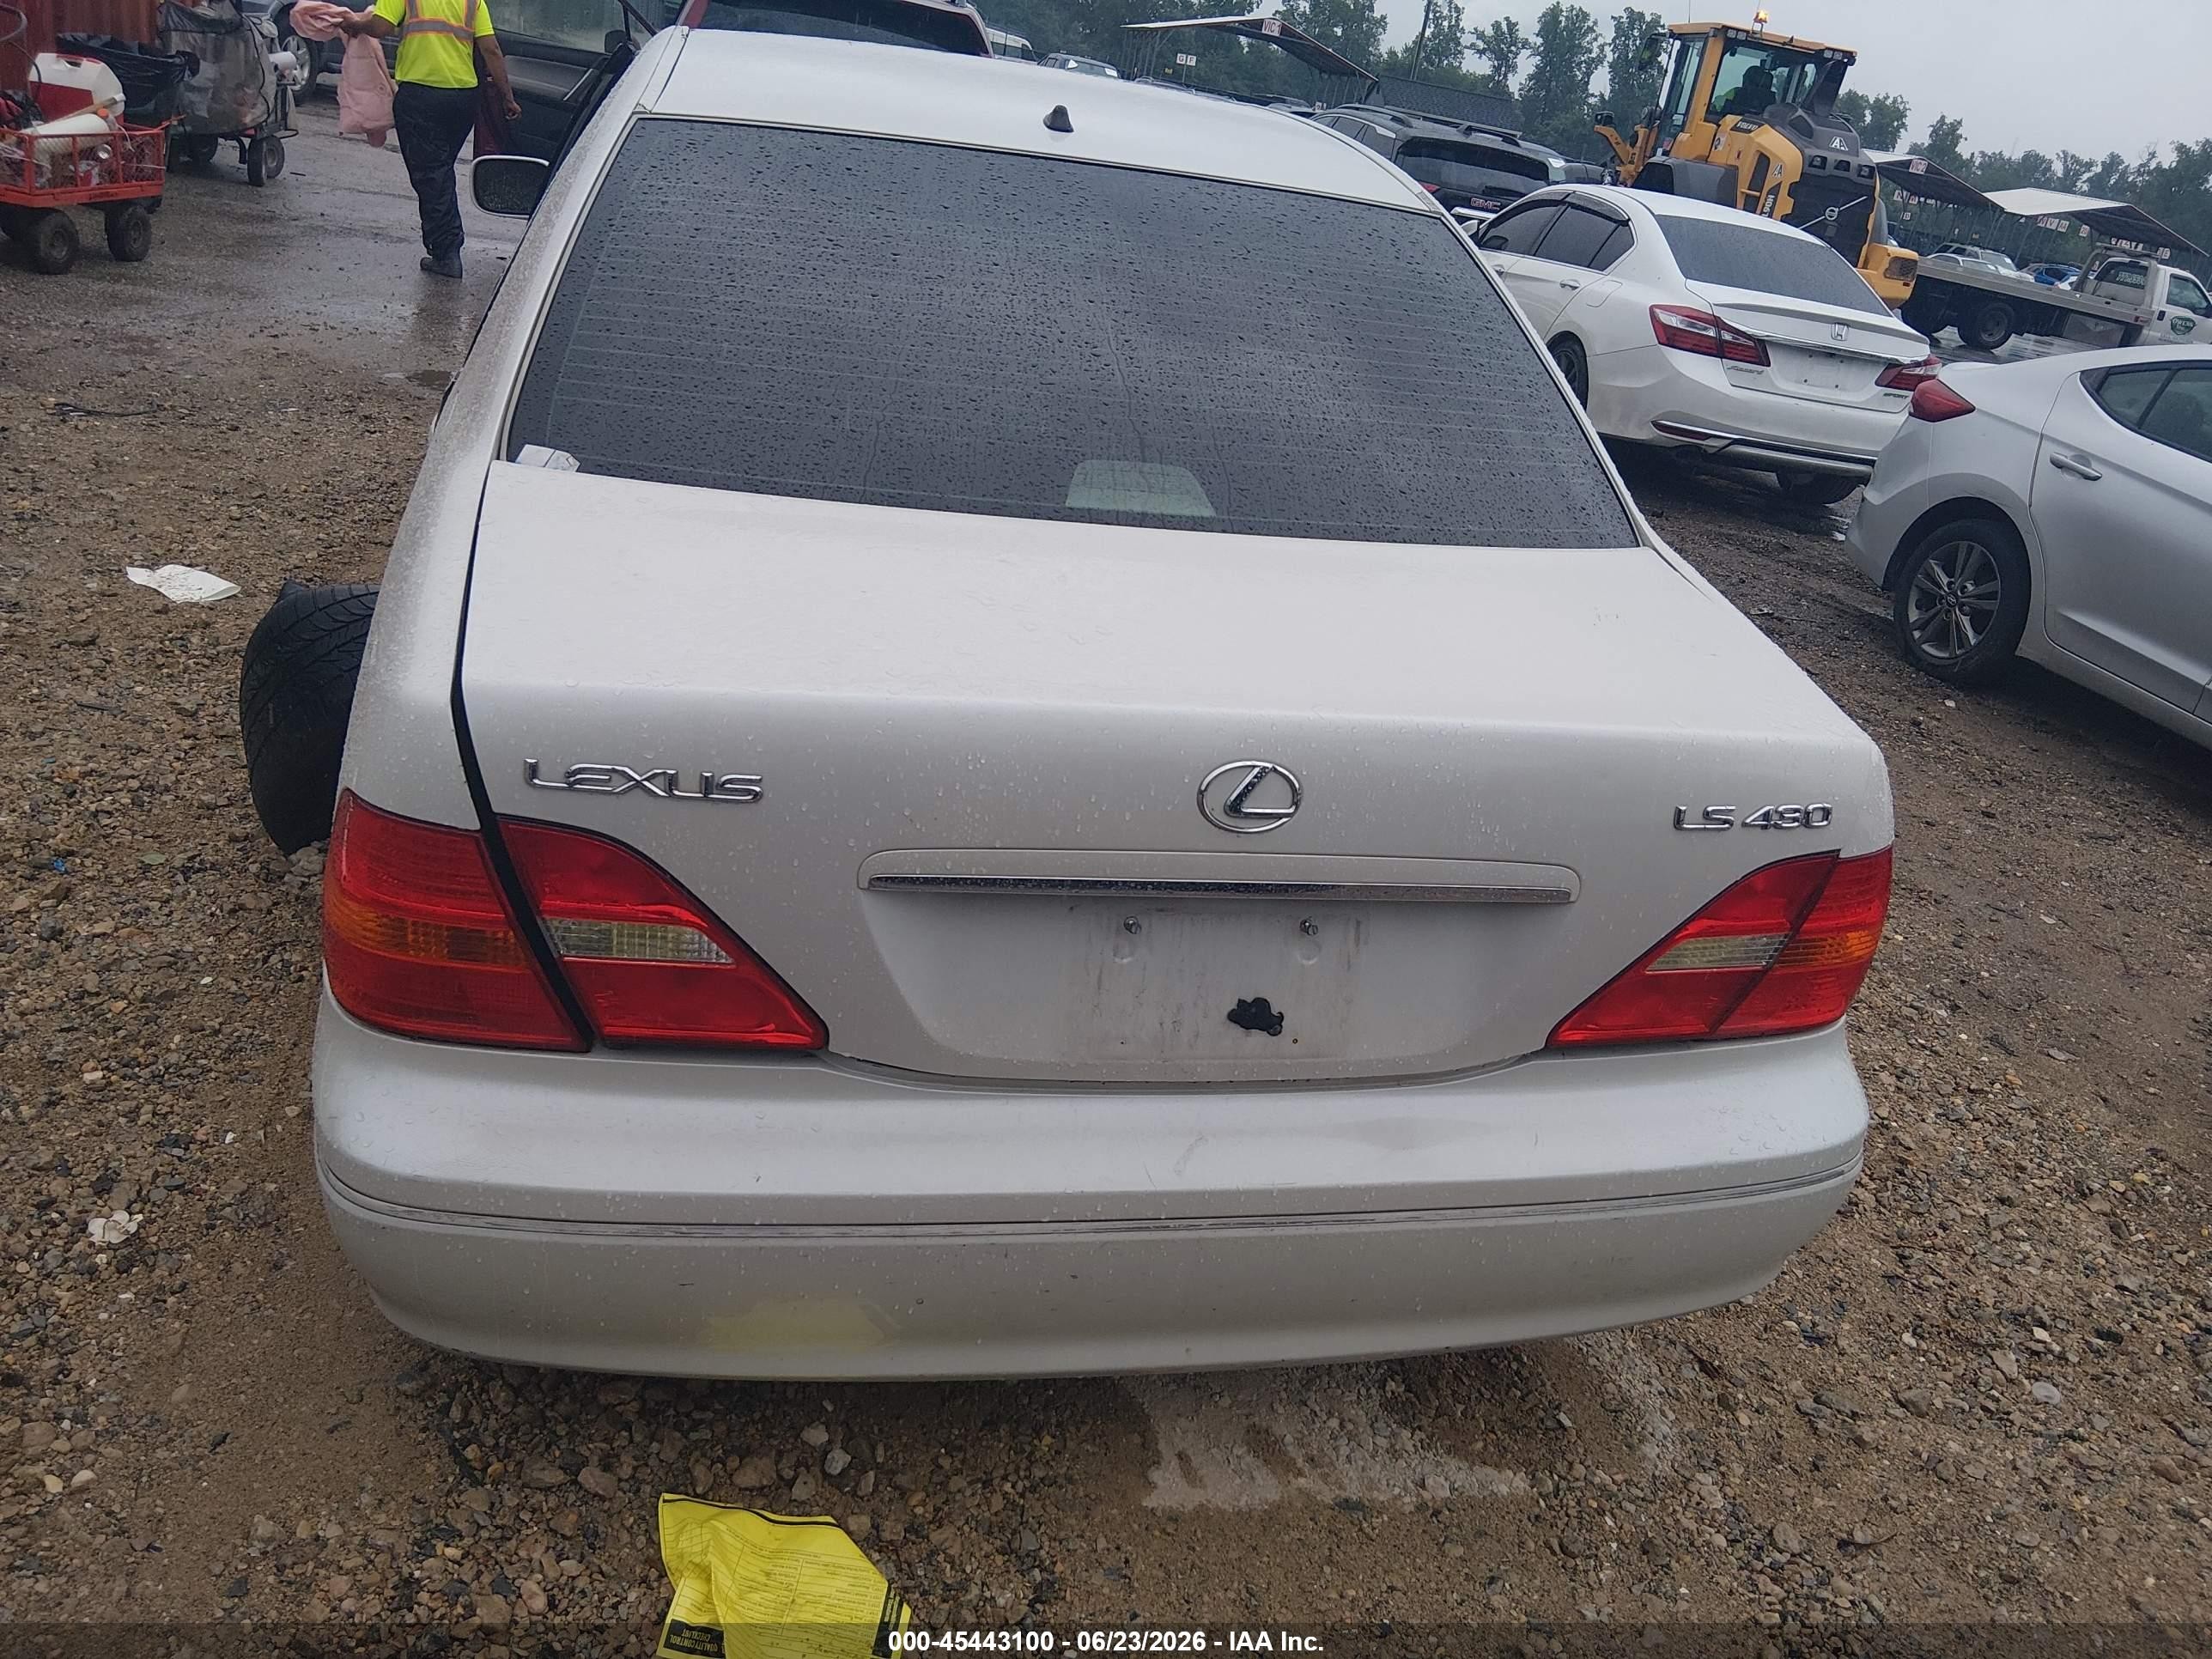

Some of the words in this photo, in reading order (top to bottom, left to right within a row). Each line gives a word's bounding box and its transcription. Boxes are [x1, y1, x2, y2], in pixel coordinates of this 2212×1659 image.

[1263, 20, 1275, 33] VIC
[1276, 22, 1282, 34] 1
[1470, 198, 1501, 210] GMC
[523, 757, 763, 803] LEXUS
[1674, 805, 1736, 830] LS
[1741, 803, 1833, 830] 430
[671, 1634, 696, 1648] CONTROL
[681, 1628, 711, 1642] CHECKLIST
[696, 1641, 719, 1652] QUALITY
